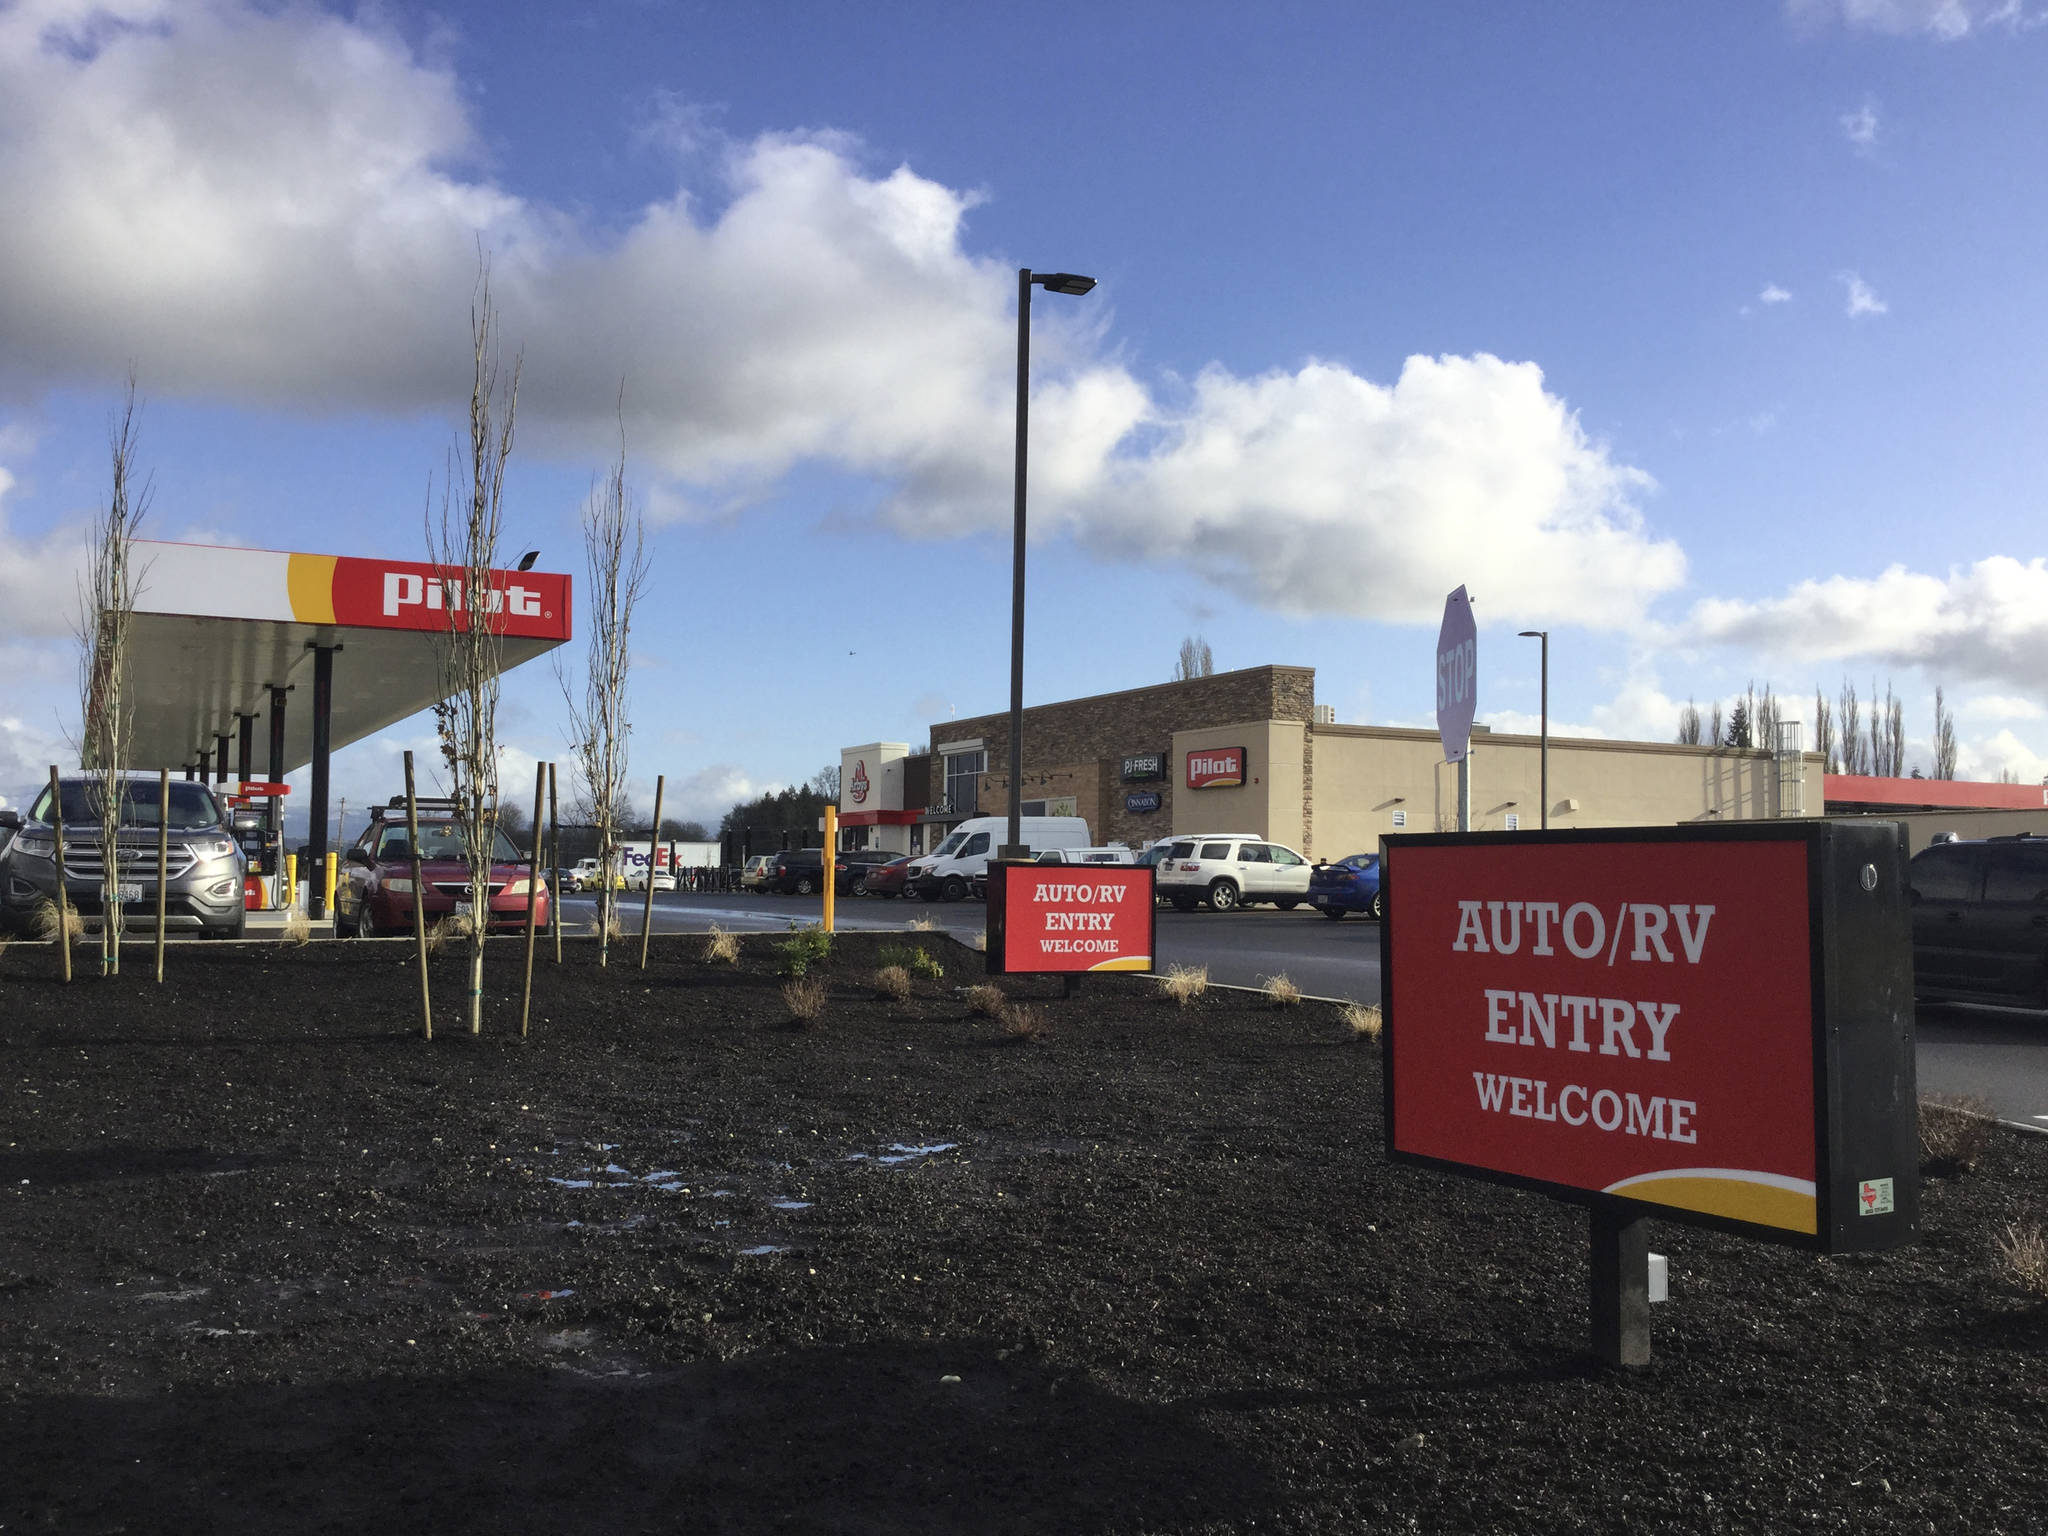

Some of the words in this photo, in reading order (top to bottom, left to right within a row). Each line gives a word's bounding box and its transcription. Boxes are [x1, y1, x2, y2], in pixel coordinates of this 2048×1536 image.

[1438, 639, 1474, 712] STOP
[1190, 757, 1238, 781] Pilot
[1033, 884, 1126, 904] AUTO/RV
[1045, 912, 1115, 931] ENTRY
[1452, 900, 1716, 966] AUTO/RV
[1040, 939, 1119, 953] WELCOME
[1484, 989, 1681, 1062] ENTRY
[1472, 1071, 1697, 1144] WELCOME
